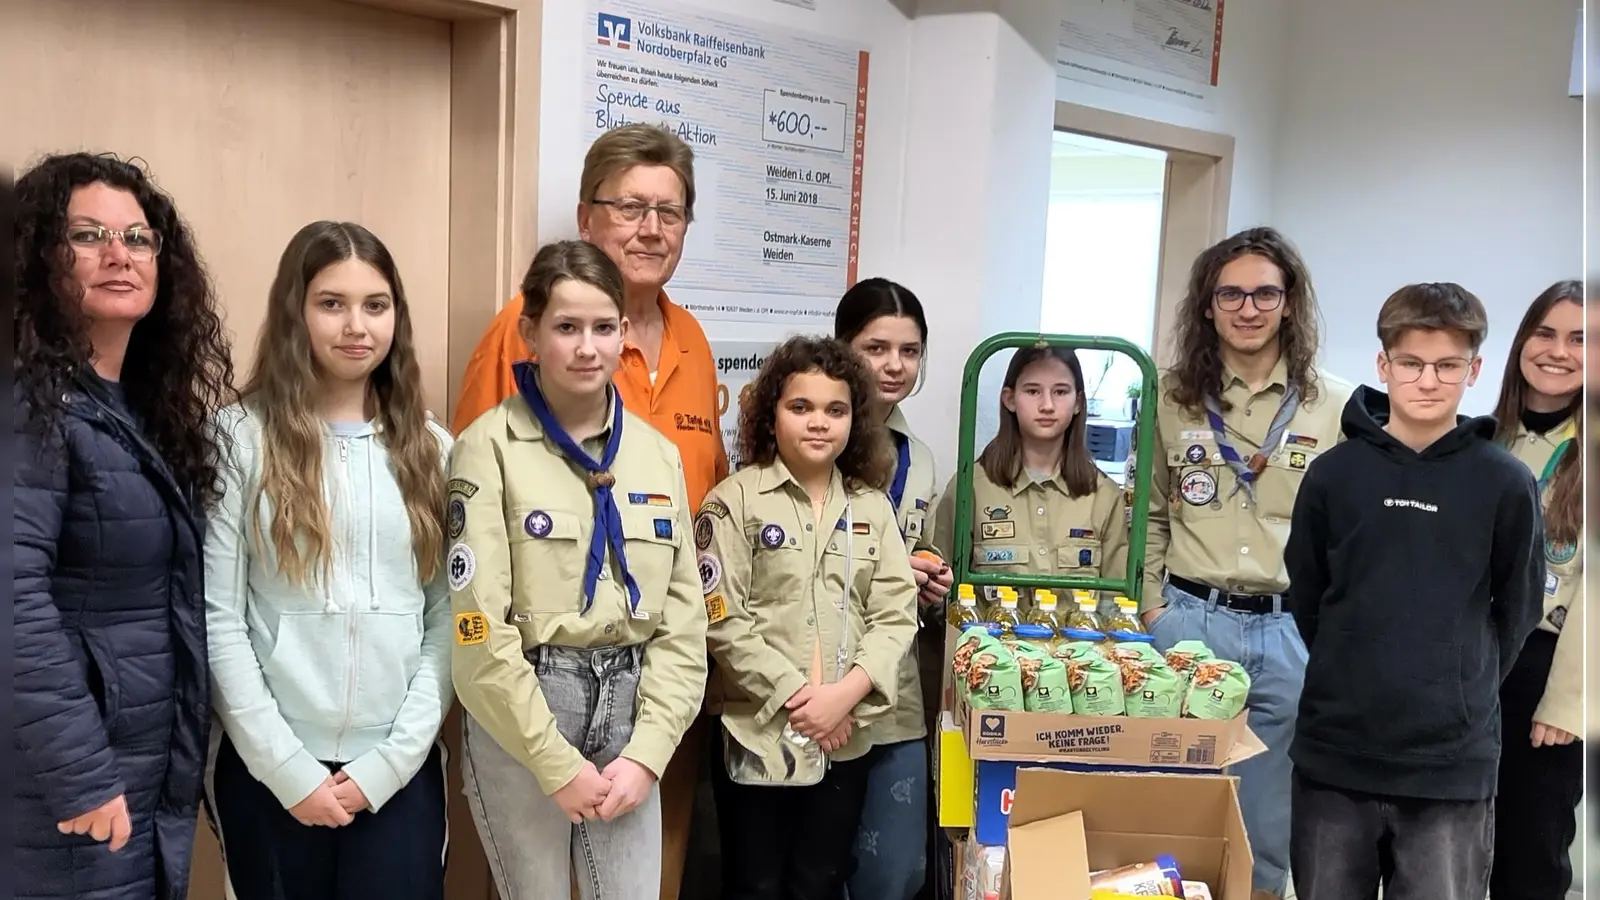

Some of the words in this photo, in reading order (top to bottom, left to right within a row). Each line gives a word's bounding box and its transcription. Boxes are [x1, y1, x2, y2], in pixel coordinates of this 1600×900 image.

[637, 21, 691, 45] Volksbank
[693, 33, 766, 59] Raiffeisenbank
[636, 39, 711, 65] Nordoberpfalz
[713, 55, 728, 68] eG
[596, 59, 607, 68] Wir
[608, 60, 627, 72] freuen
[640, 67, 657, 77] Ihnen
[657, 70, 673, 80] heute
[674, 72, 700, 84] folgenden
[701, 78, 718, 88] Scheck
[596, 70, 630, 82] überreichen
[596, 84, 648, 111] Spende
[655, 99, 681, 115] aus
[766, 165, 798, 180] Weiden
[799, 169, 804, 181] i.
[805, 170, 814, 182] d.
[815, 172, 832, 184] OPf.
[766, 188, 778, 200] 15.
[779, 189, 797, 202] Juni
[798, 192, 818, 205] 2018
[763, 231, 832, 248] Ostmark-Kaserne
[763, 248, 794, 260] Weiden
[1410, 500, 1439, 513] TAILOR
[1036, 733, 1051, 742] ICH
[1055, 728, 1084, 739] KOMM
[1086, 725, 1125, 736] WIEDER.
[1048, 737, 1077, 748] KEINE
[1078, 735, 1110, 746] FRAGE!
